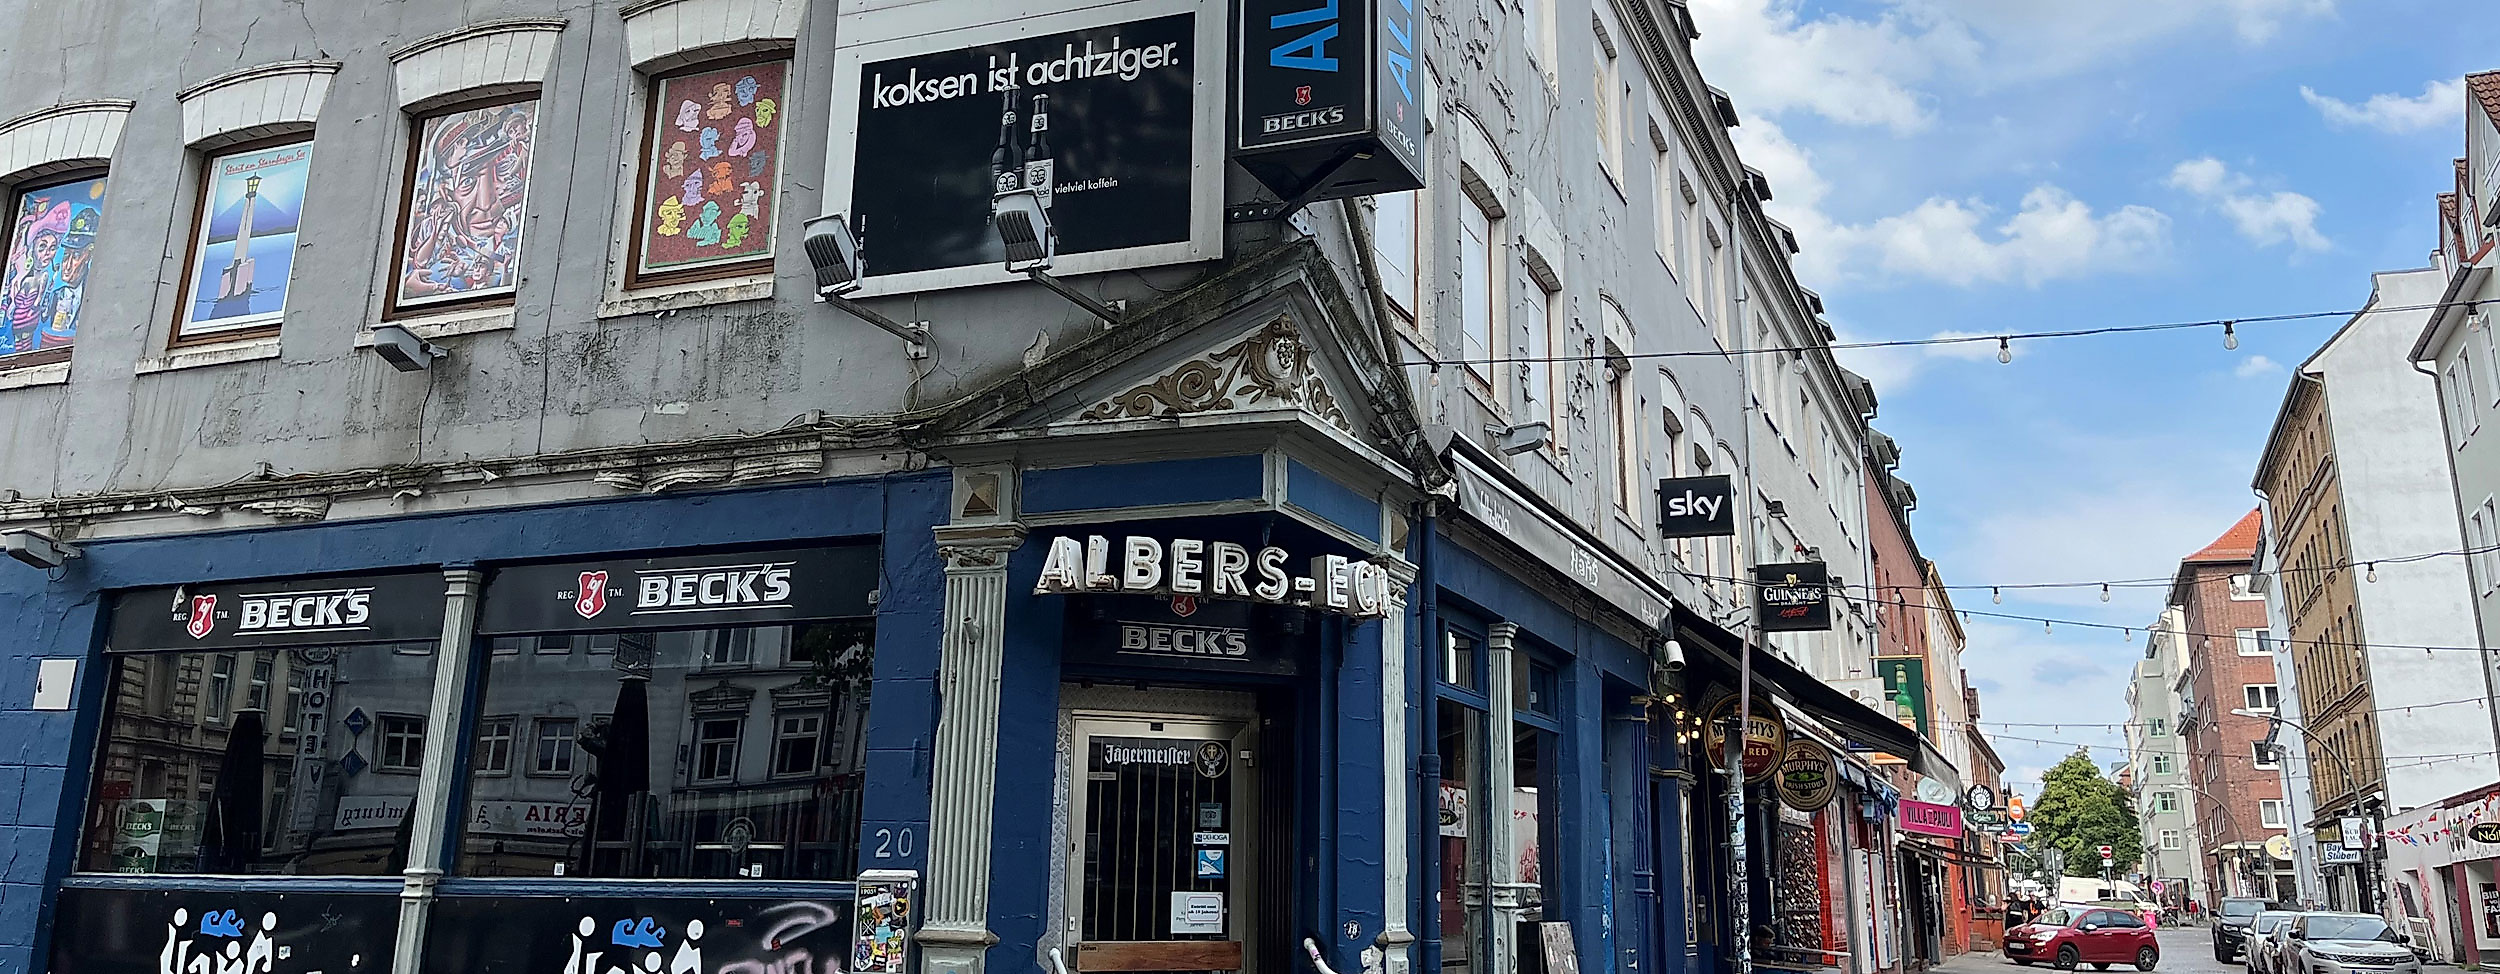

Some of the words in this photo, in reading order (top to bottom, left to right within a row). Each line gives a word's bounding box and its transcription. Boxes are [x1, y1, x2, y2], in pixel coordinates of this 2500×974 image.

[873, 67, 977, 109] koksen
[988, 52, 1019, 92] ist
[1026, 36, 1179, 86] achtziger.
[1263, 106, 1344, 134] BECK'S
[1386, 117, 1416, 157] BECK'S
[1054, 180, 1086, 195] vielviel
[1088, 176, 1118, 191] koffein
[1668, 489, 1724, 522] sky
[637, 563, 792, 608] BECK'S
[239, 588, 370, 630] BECK'S
[1121, 625, 1248, 655] BECK'S
[1748, 747, 1769, 756] RED
[875, 827, 913, 858] 20
